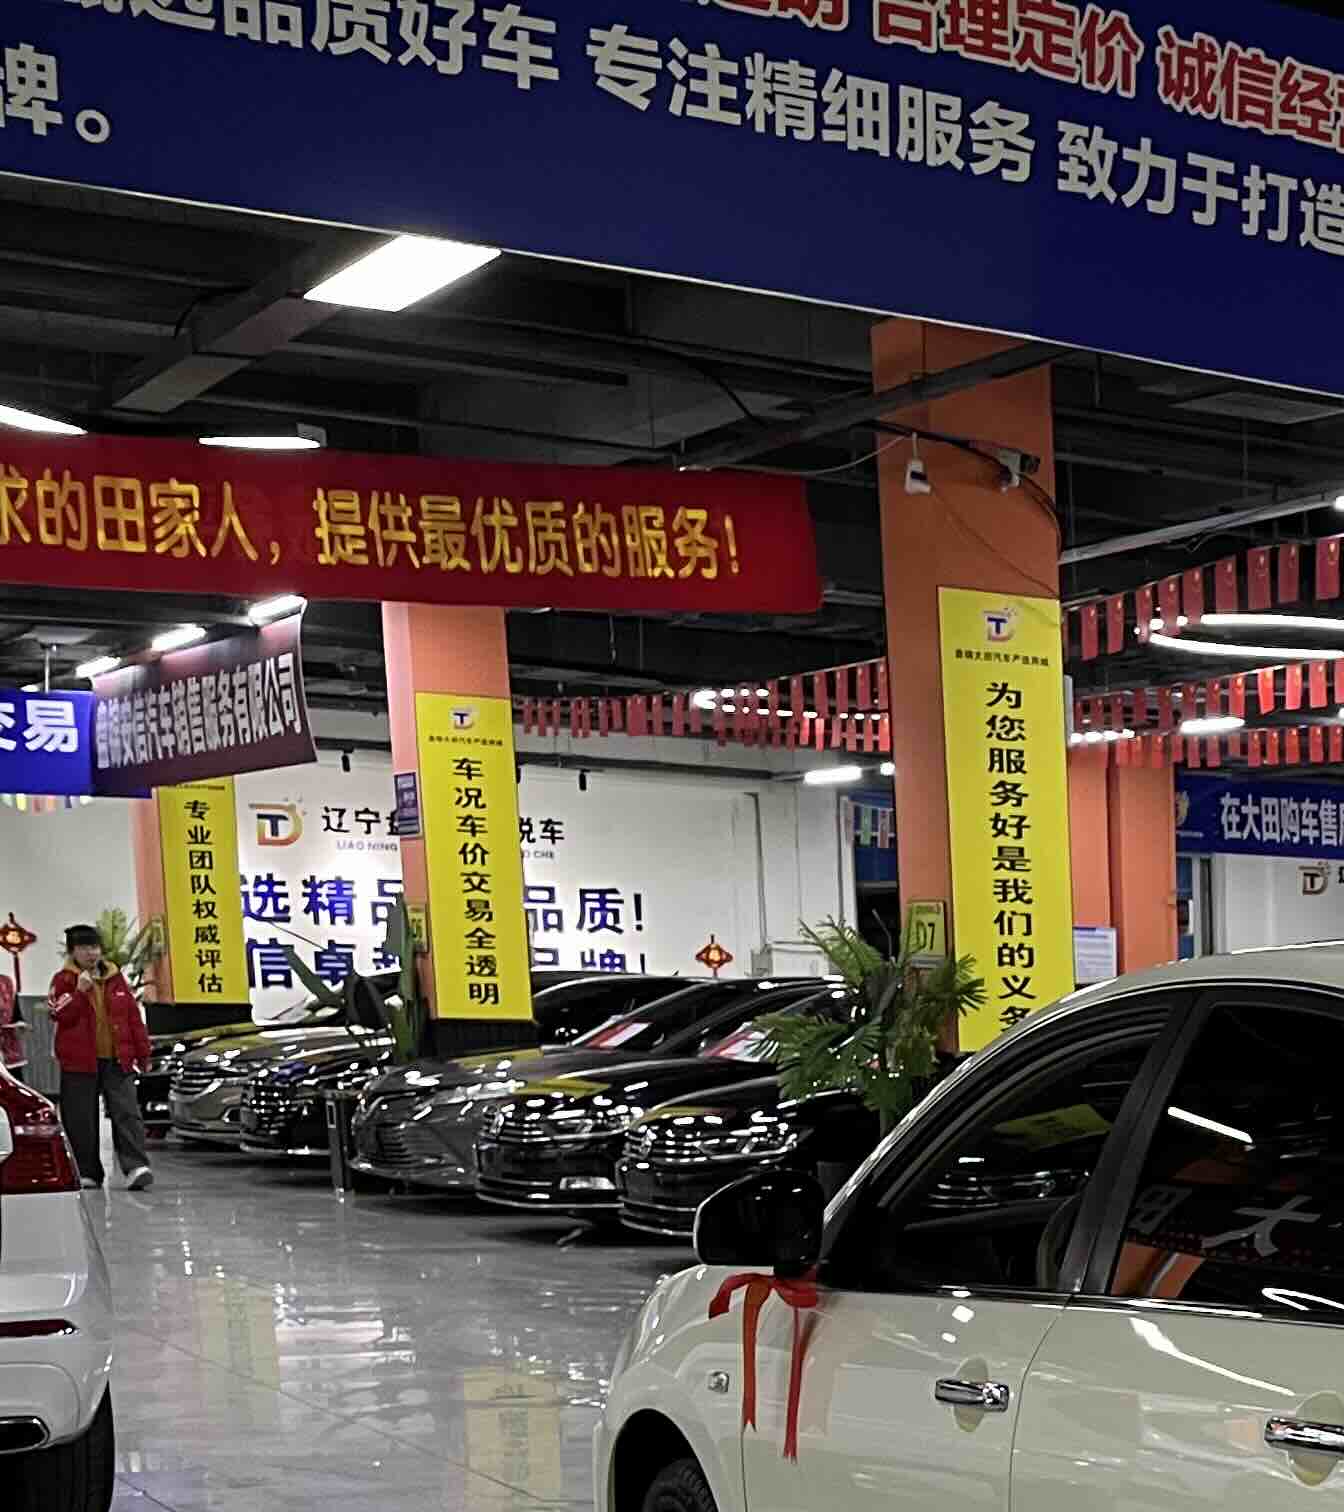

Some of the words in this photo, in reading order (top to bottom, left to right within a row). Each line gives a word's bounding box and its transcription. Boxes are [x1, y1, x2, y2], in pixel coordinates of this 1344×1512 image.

[586, 24, 1036, 182] 专注精细服务
[0, 699, 79, 753] 易
[184, 800, 224, 993] 专业团队权威评估
[452, 758, 500, 1005] 车况车价交易全透明
